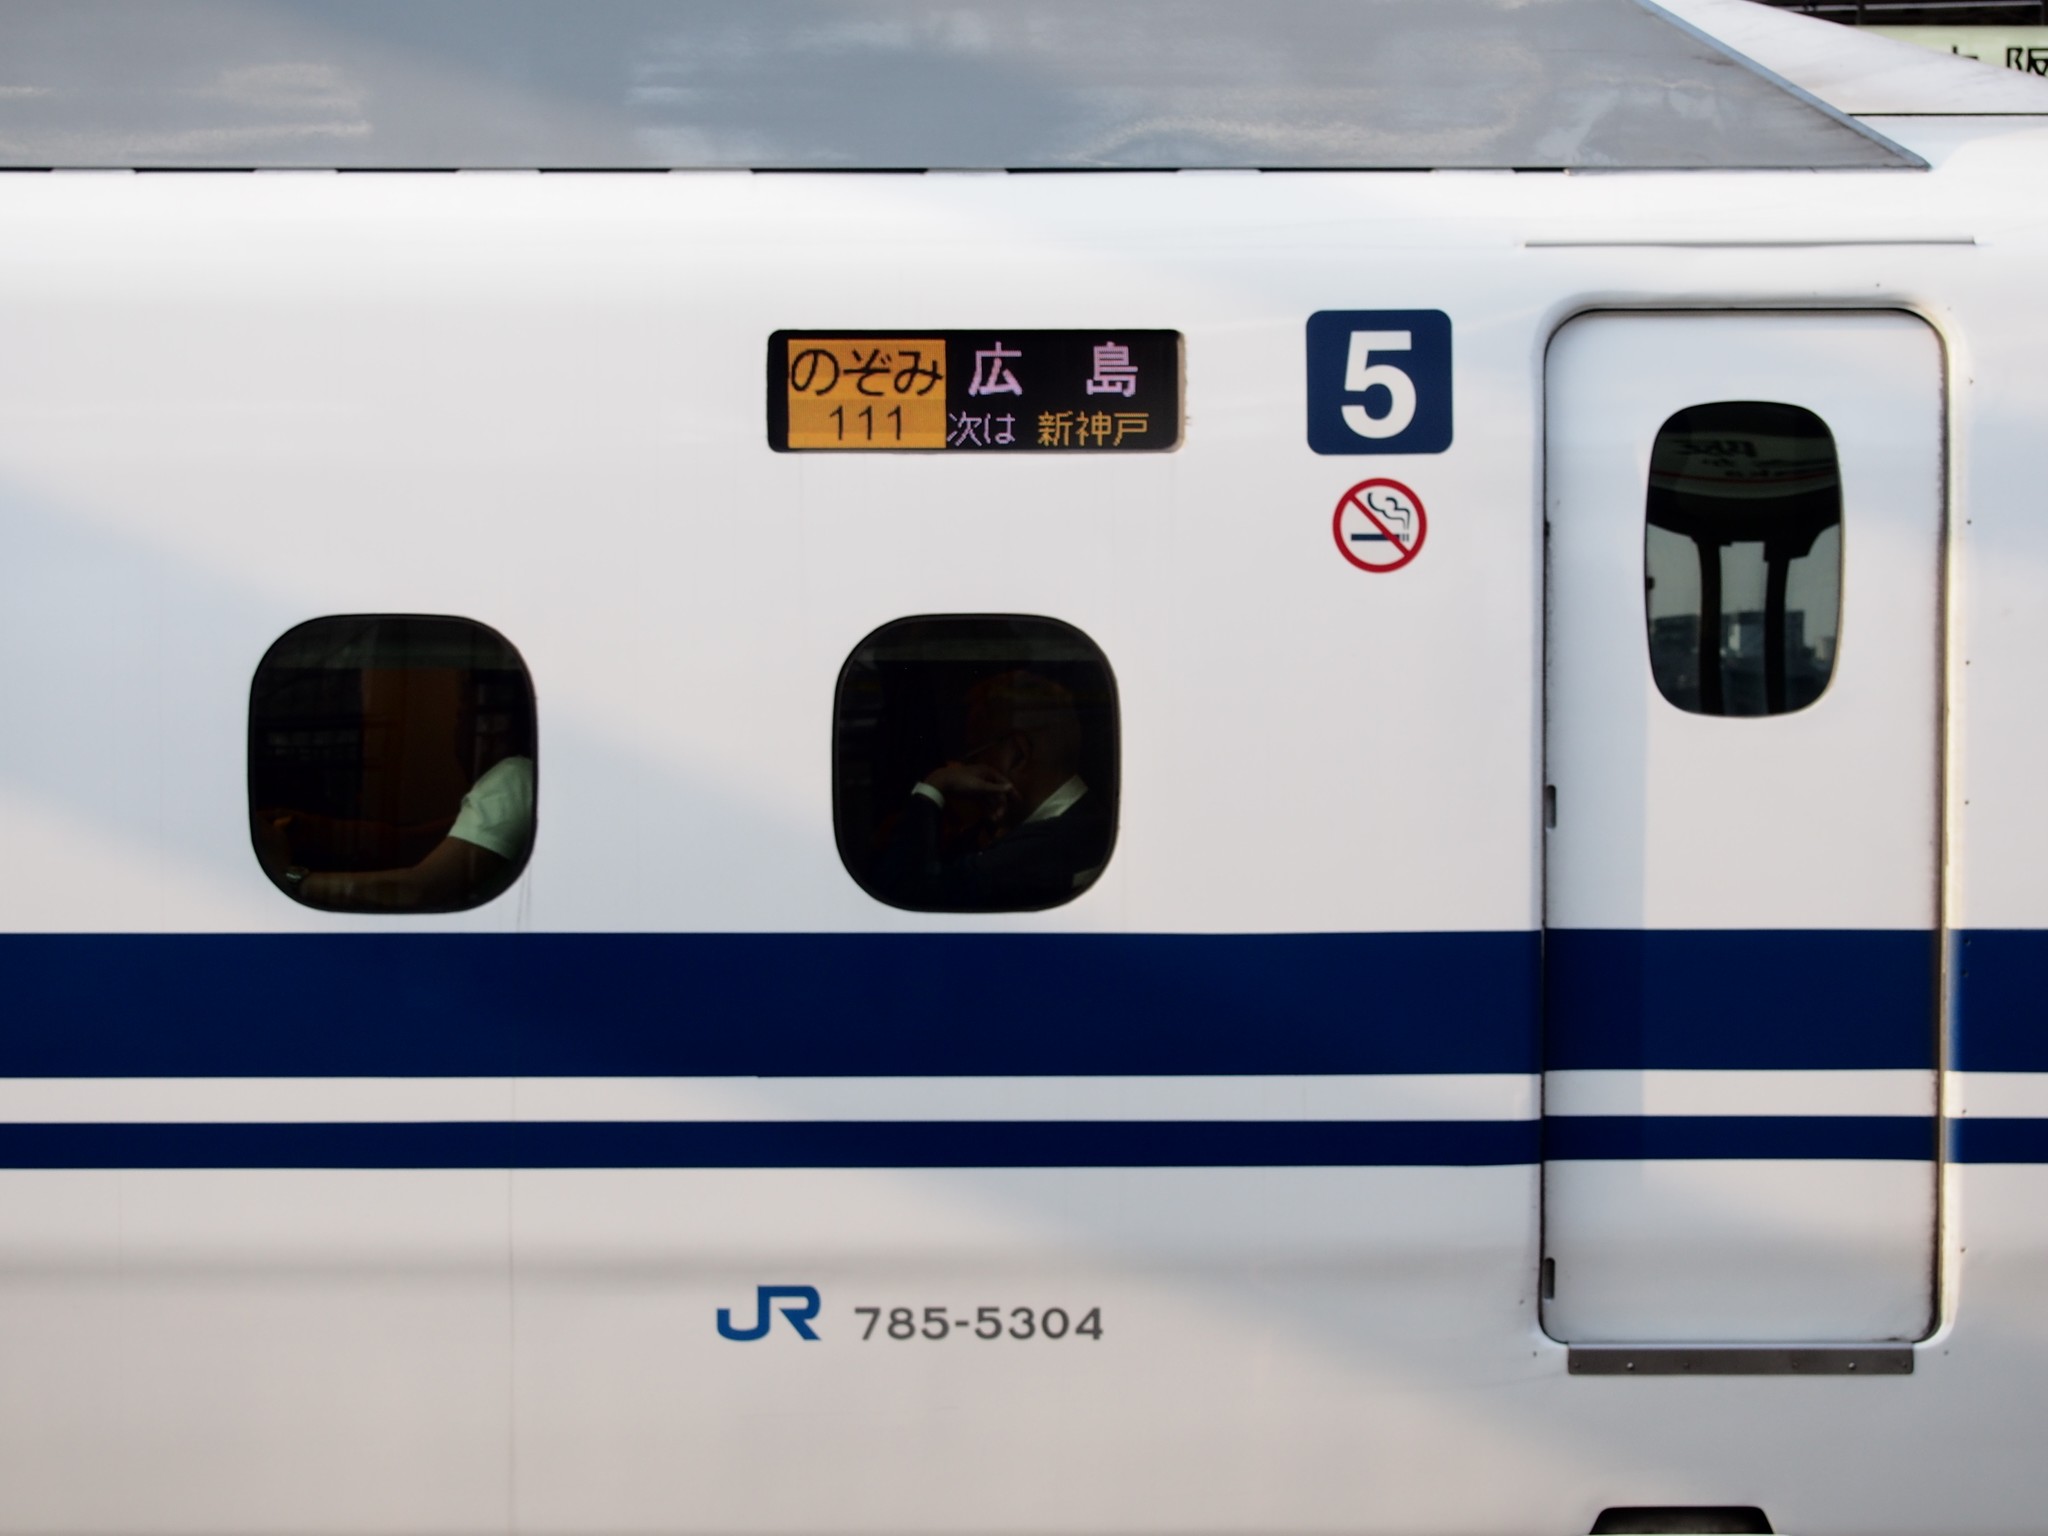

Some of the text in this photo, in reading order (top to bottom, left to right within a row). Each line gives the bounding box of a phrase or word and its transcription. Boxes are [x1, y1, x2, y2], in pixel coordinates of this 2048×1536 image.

[790, 347, 944, 397] のぞみ
[1341, 330, 1417, 439] 5
[829, 405, 904, 441] 111
[946, 410, 1149, 447] 次は 新神戸
[716, 1284, 822, 1342] JR
[854, 1306, 1104, 1341] 785-5304
